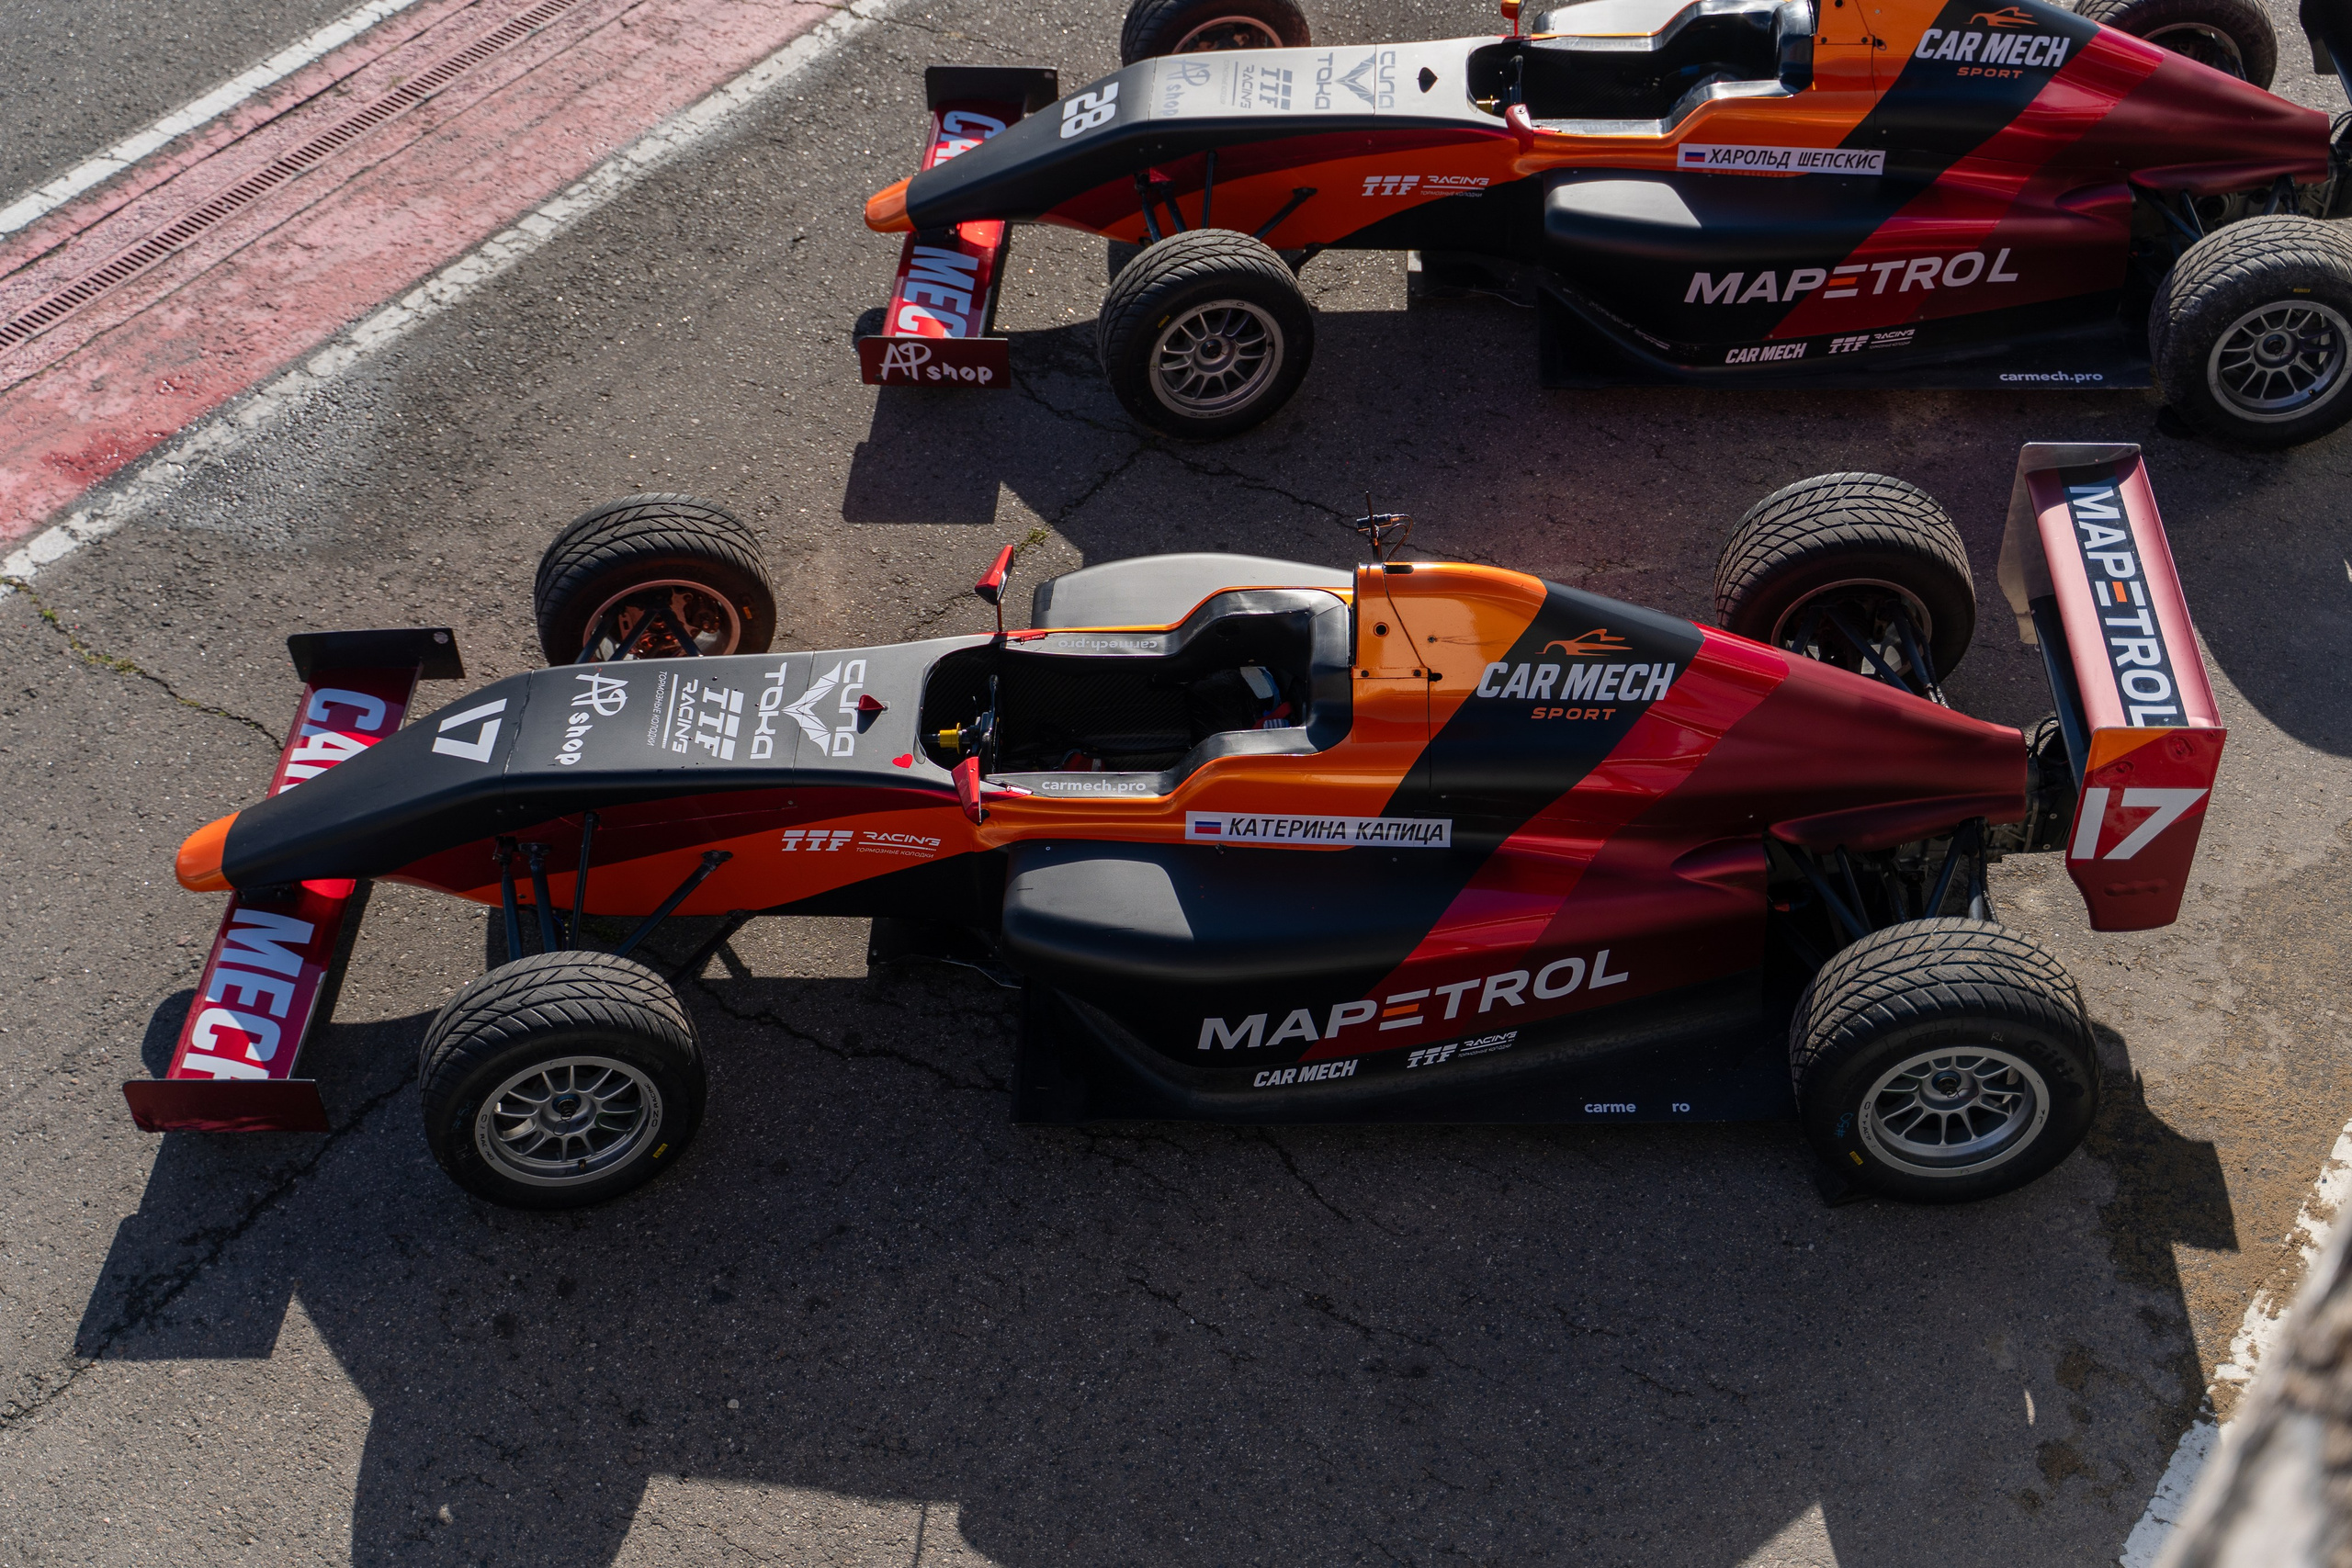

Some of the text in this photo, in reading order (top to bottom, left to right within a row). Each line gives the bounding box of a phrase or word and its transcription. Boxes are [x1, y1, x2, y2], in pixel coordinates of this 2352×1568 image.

[1915, 28, 2071, 68] CAR MECH
[1957, 67, 2023, 79] SPORT
[1060, 82, 1119, 139] 28
[1159, 83, 1185, 117] shop
[1708, 148, 1881, 169] ХАРОЛЬД ШЕПСКИС
[1362, 175, 1490, 197] TTF RACING
[896, 245, 979, 338] MEC
[1683, 248, 2018, 304] MAPETROL
[1725, 342, 1808, 364] CAR MECH
[1828, 334, 1870, 355] TTF
[1873, 329, 1916, 340] RACING
[926, 362, 993, 385] shop
[1999, 370, 2103, 383] carmech.pro
[2069, 486, 2177, 728] MAPETROL
[1057, 638, 1158, 650] carmech.pro
[1476, 661, 1676, 701] CAR MECH
[646, 671, 668, 747] ТОРМОЗНЫЕ КОЛОДКИ
[672, 679, 698, 754] RACING
[695, 686, 744, 761] TTF
[1531, 706, 1617, 720] SPORT
[278, 688, 386, 795] CA
[432, 698, 507, 763] 17
[554, 712, 594, 765] shop
[1041, 779, 1147, 793] carmech.pro
[781, 829, 941, 852] TTF RACING
[1228, 818, 1444, 845] КАТЕРИНА КАПИЦА
[2071, 787, 2209, 860] 17
[855, 847, 899, 855] ТОРМОЗНЫЕ
[1197, 949, 1630, 1051] MAPETROL
[1407, 1031, 1518, 1068] TTF RACING
[1253, 1059, 1359, 1088] CAR MECH
